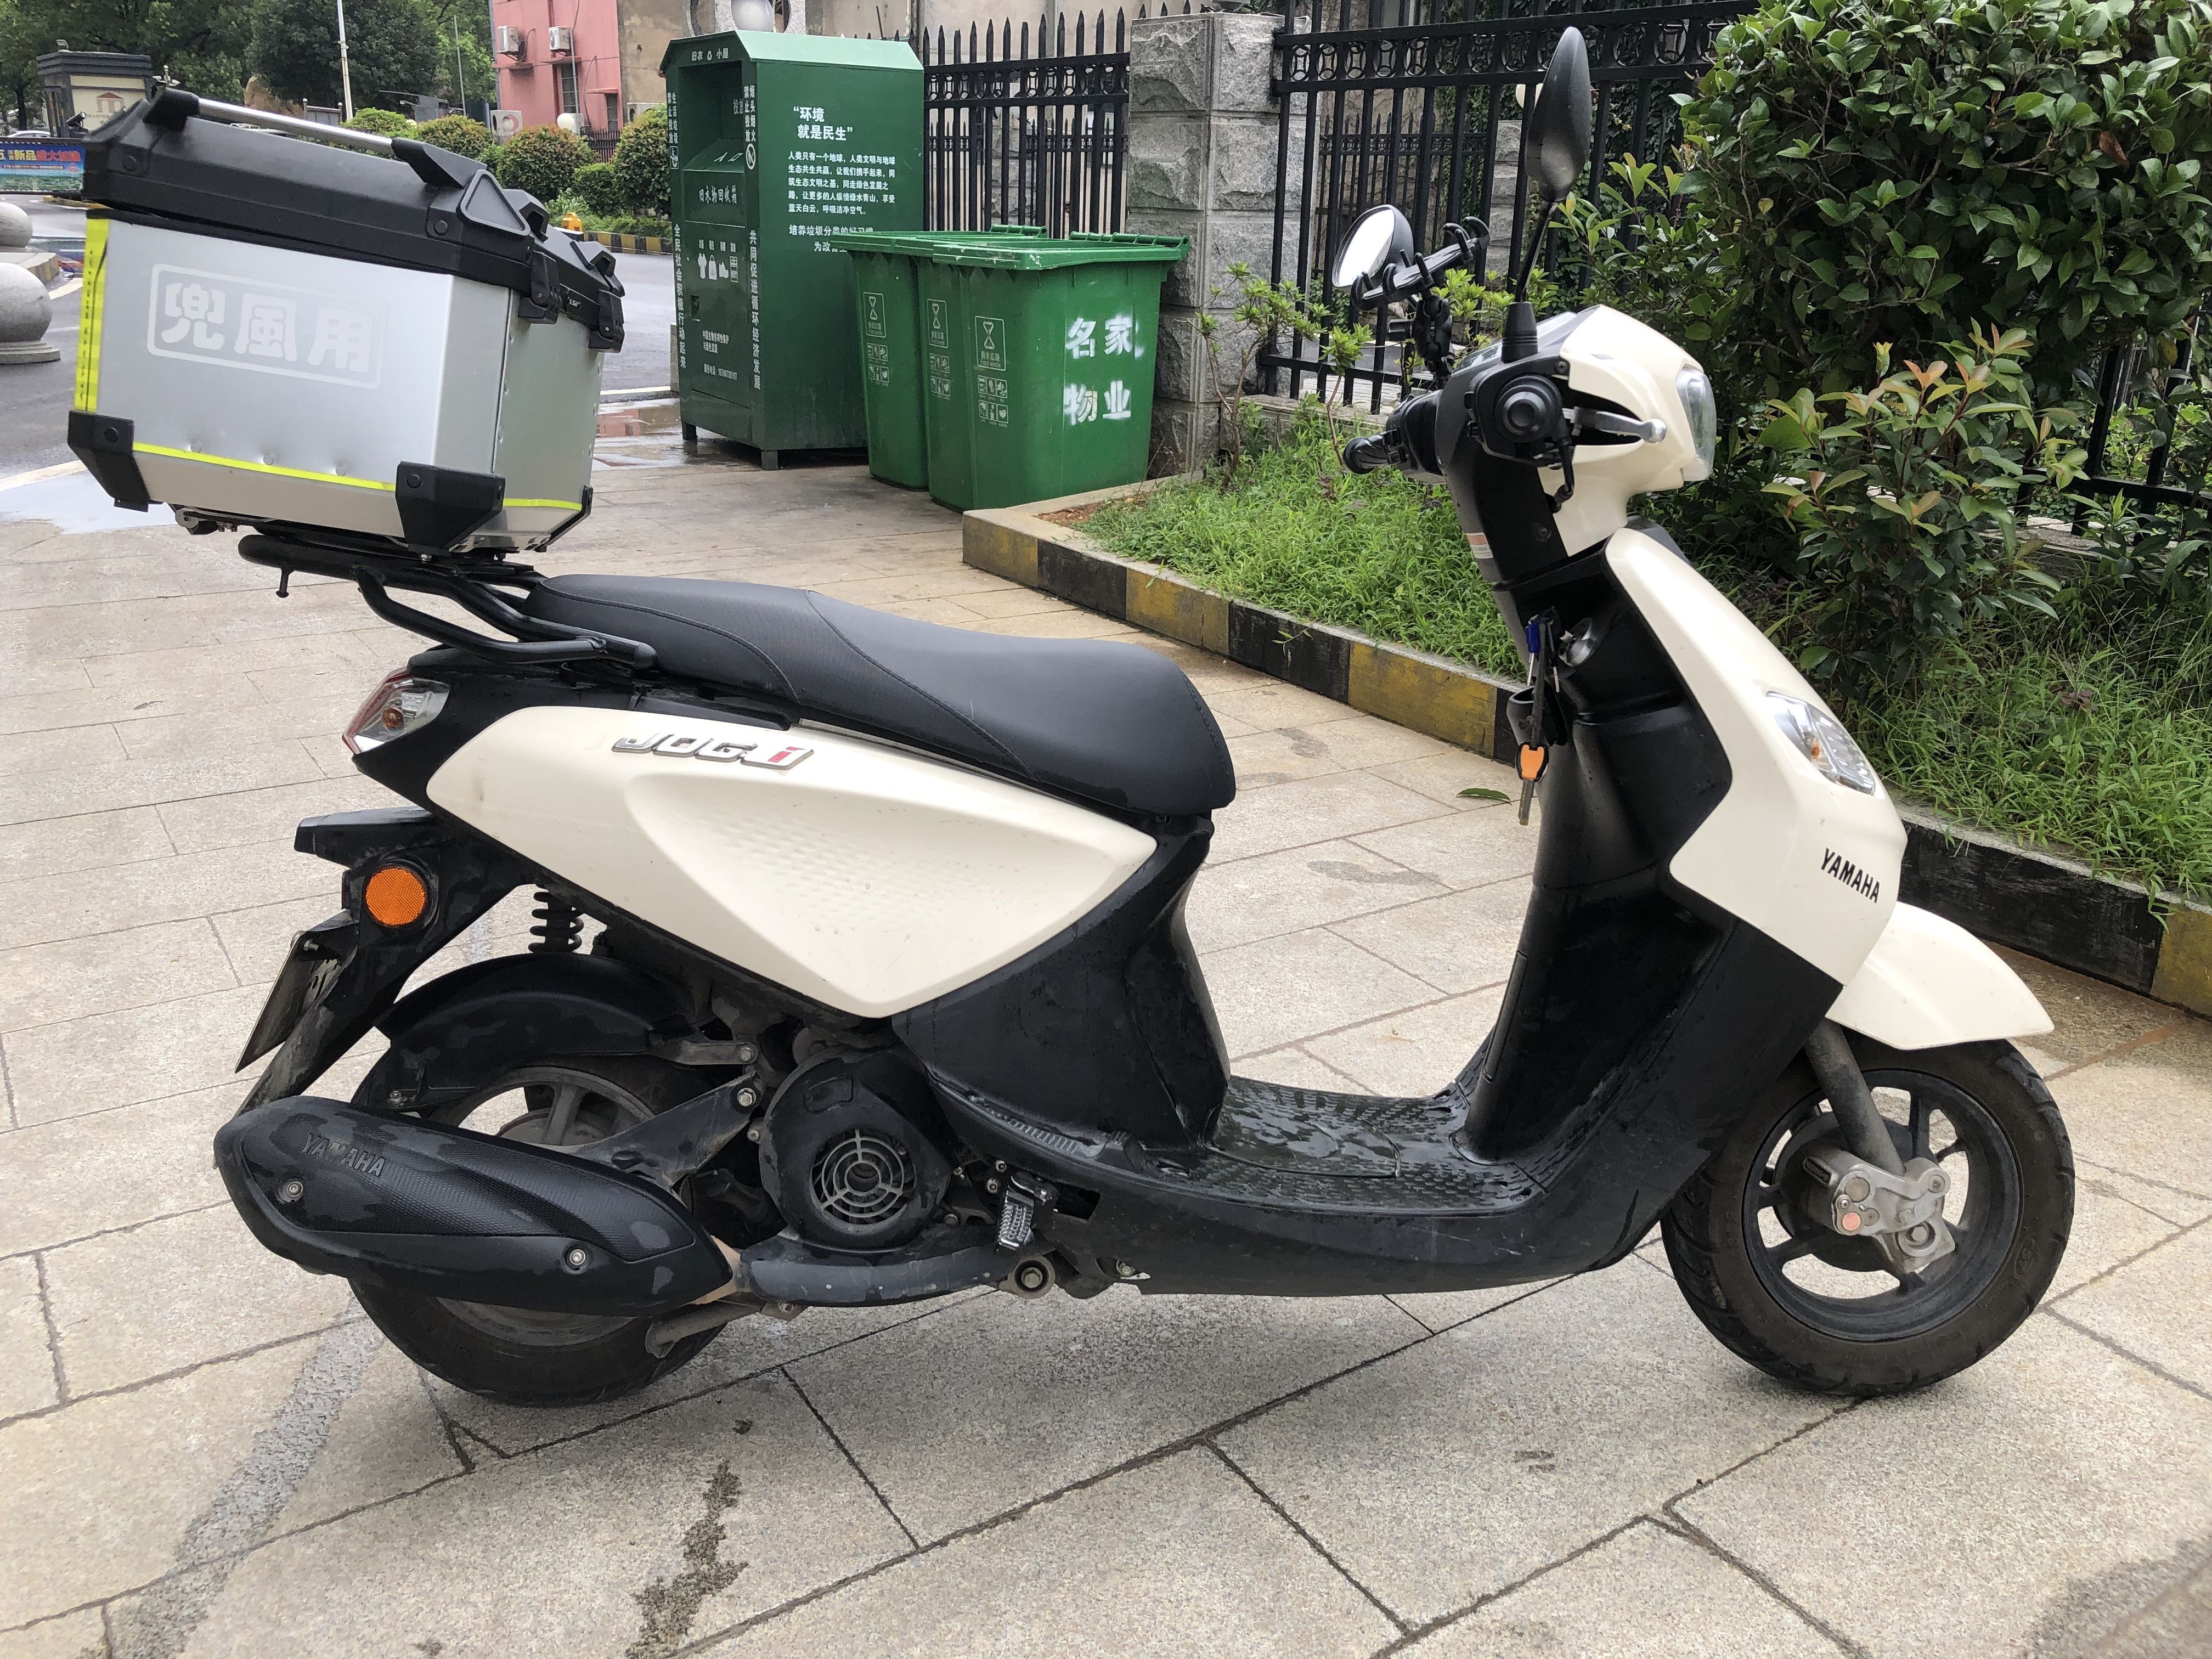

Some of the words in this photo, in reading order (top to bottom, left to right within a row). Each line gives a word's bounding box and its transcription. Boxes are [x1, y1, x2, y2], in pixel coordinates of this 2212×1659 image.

[691, 50, 703, 61] 旧衣
[716, 47, 729, 59] 小屋
[699, 184, 737, 205] 旧衣物回收箱
[814, 241, 848, 253] 为改
[674, 223, 686, 369] 全民社会积极行动起来
[749, 229, 761, 390] 共同促进循环经济发展
[1065, 314, 1144, 360] 名家
[1064, 380, 1131, 426] 物业
[1820, 847, 1880, 904] YAMAHA
[301, 1132, 387, 1177] YAMAHA
